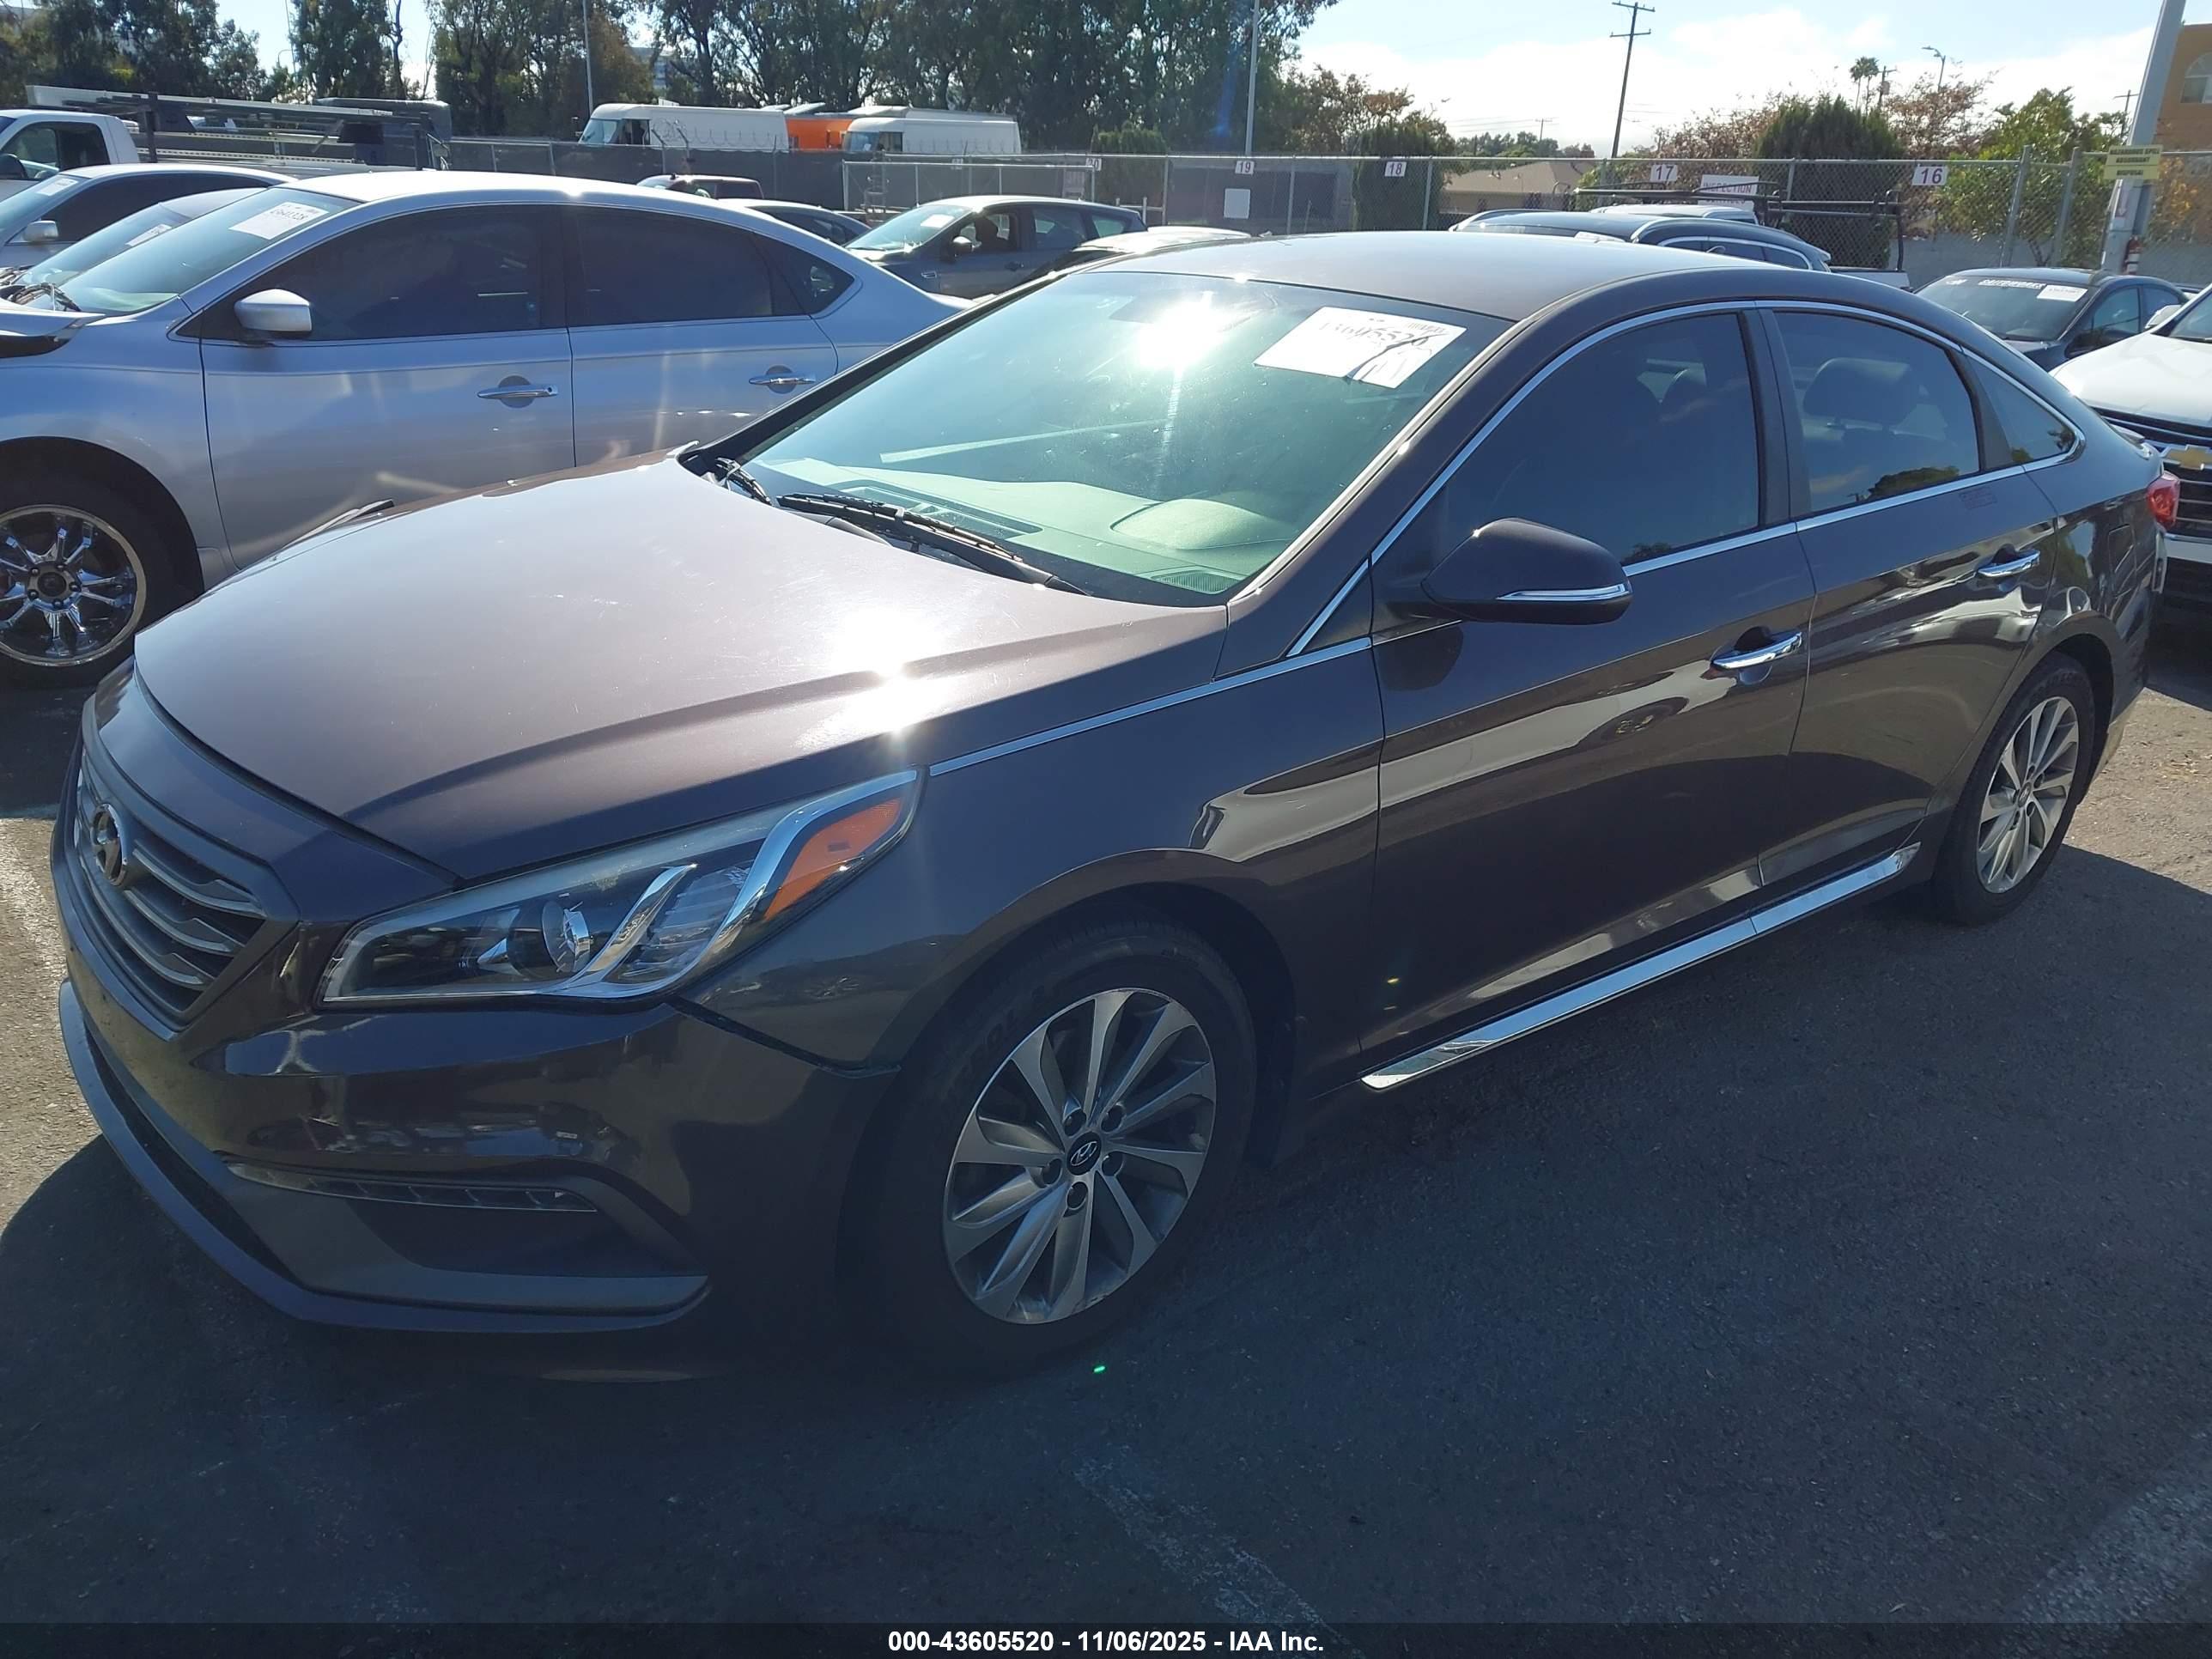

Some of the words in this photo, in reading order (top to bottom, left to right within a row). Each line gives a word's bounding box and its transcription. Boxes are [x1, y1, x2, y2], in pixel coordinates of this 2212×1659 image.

[1239, 161, 1251, 173] 19
[1389, 162, 1402, 175] 18
[1656, 165, 1674, 180] 17
[1921, 167, 1943, 185] 16
